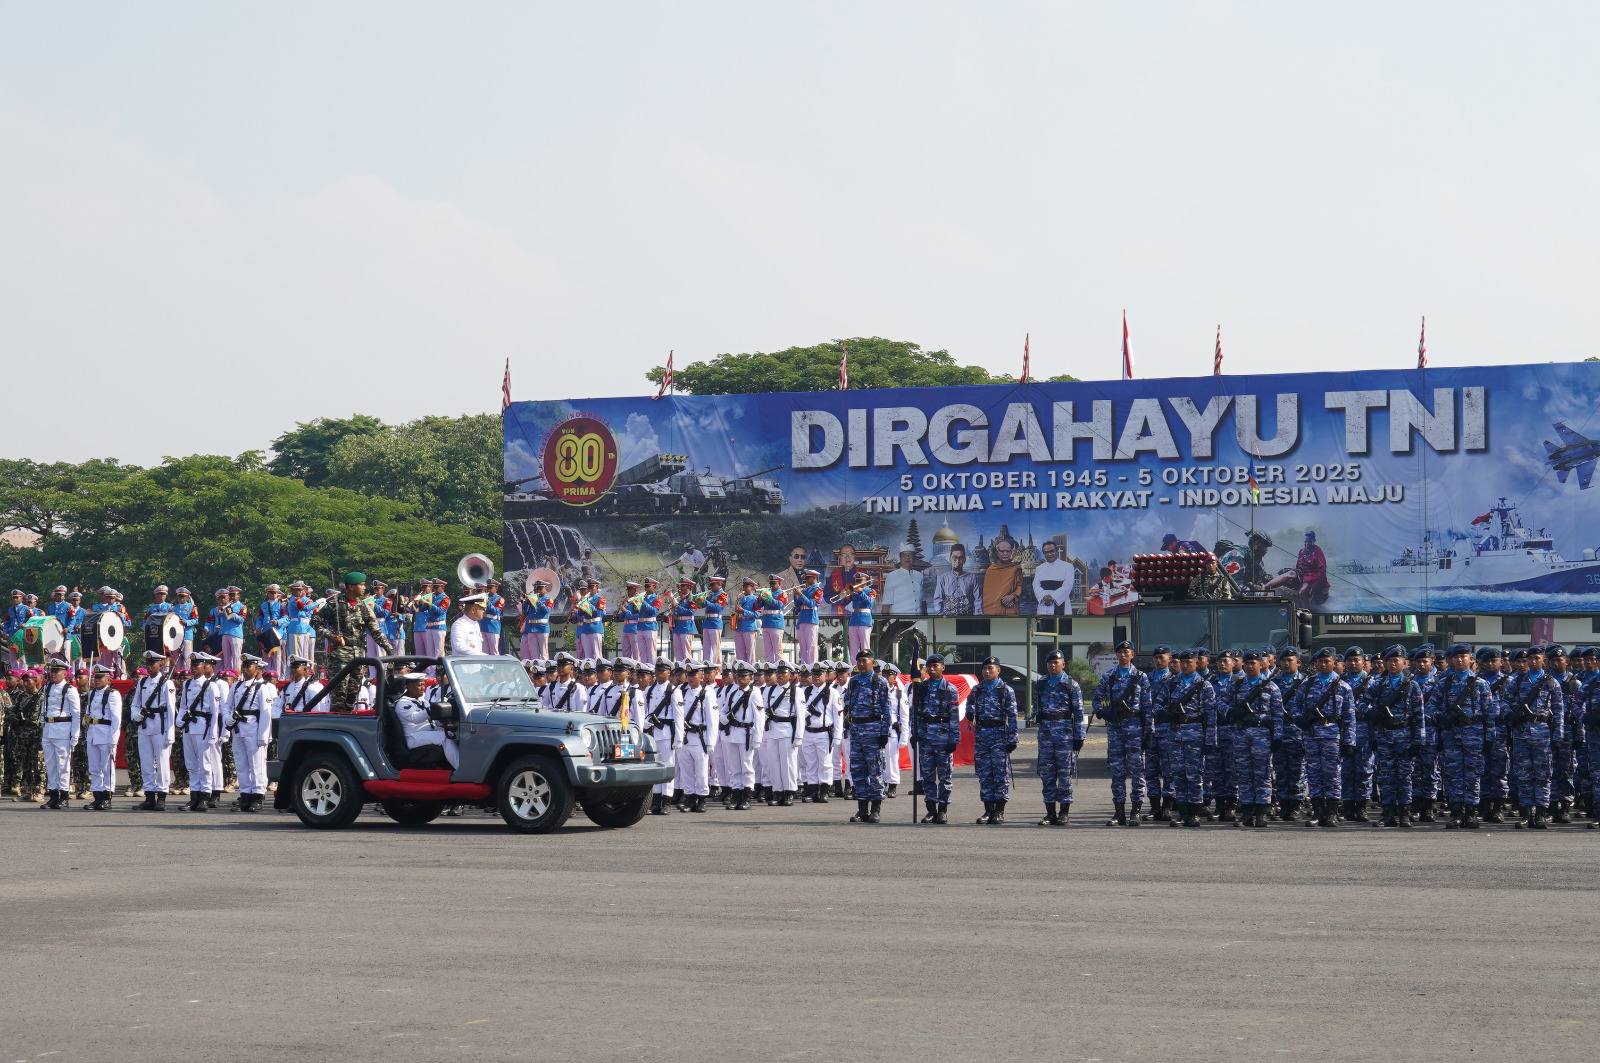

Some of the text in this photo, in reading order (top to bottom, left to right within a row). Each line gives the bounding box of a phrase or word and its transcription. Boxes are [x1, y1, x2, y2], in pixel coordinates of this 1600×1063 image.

[538, 418, 564, 460] NASIONAL
[565, 411, 611, 428] INDONESIA
[791, 386, 1486, 469] DIRGAHAYU TNI
[555, 433, 605, 483] 80
[900, 474, 913, 491] 5
[922, 471, 1037, 490] OKTOBER
[1047, 469, 1108, 488] 1945
[1138, 468, 1151, 486] 5
[1162, 464, 1285, 486] OKTOBER
[1295, 462, 1361, 482] 2025
[563, 487, 596, 496] PRIMA
[862, 496, 899, 513] TNI
[907, 493, 985, 512] PRIMA
[1009, 492, 1048, 510] TNI
[1055, 489, 1152, 509] RAKYAT
[1178, 486, 1318, 506] INDONESIA
[1326, 484, 1405, 504] MAJU
